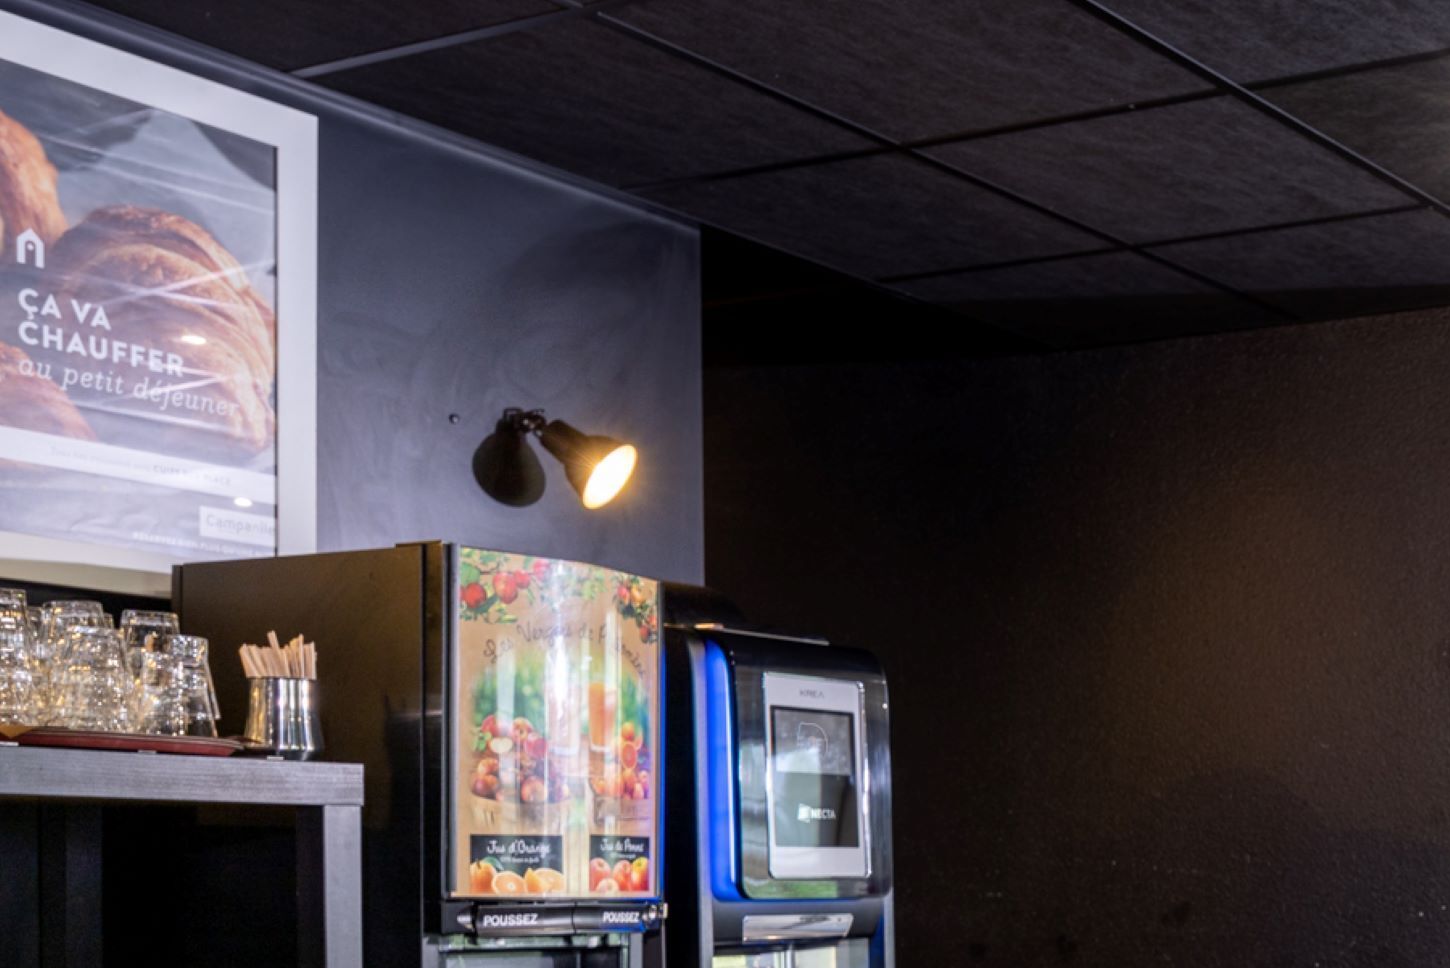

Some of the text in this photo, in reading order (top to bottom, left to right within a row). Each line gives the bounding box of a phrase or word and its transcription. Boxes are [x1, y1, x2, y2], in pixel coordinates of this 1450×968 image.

[18, 288, 112, 331] ÇA VA
[18, 321, 184, 377] CHAUFFER
[18, 358, 240, 417] au petit déjeuner
[487, 840, 505, 853] Jus
[483, 913, 539, 927] POUSSEZ
[602, 911, 640, 923] POUSSEZ
